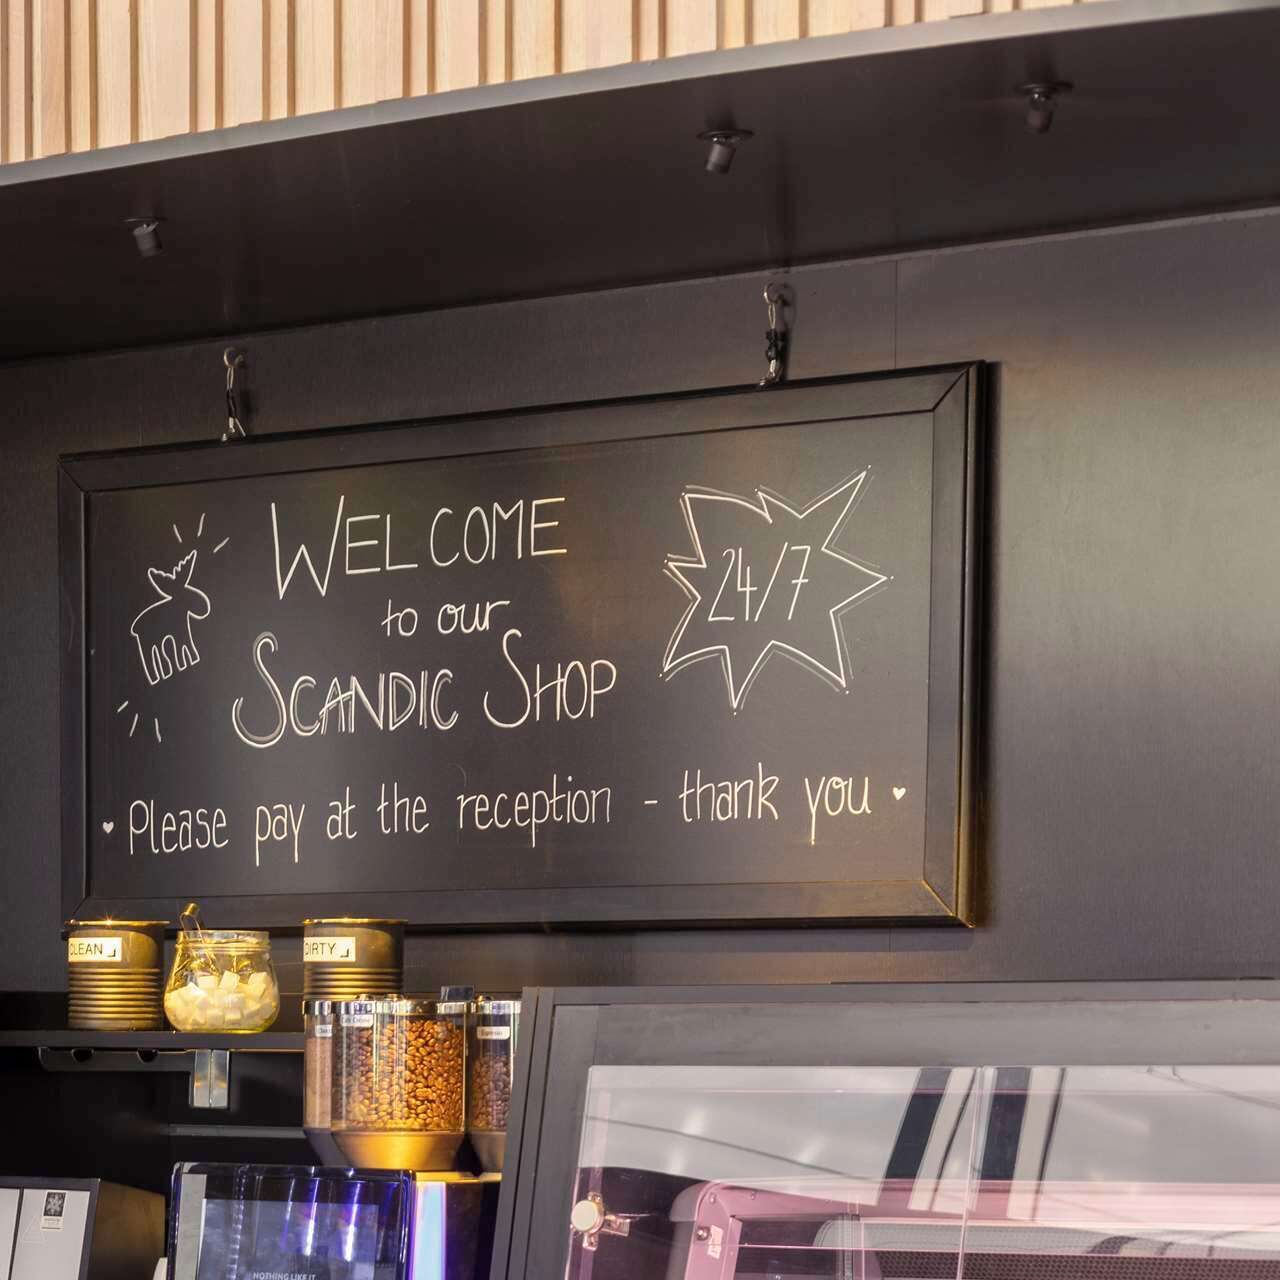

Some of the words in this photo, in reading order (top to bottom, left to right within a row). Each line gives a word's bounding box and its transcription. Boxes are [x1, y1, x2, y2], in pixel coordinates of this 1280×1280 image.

[270, 494, 568, 601] WELCOME
[706, 542, 811, 623] 24/7
[381, 599, 418, 637] to
[437, 598, 513, 635] our
[231, 631, 460, 749] SCANDIC
[483, 630, 618, 729] SHOP
[130, 799, 228, 855] Please
[255, 804, 305, 867] pay
[326, 786, 358, 840] at
[376, 781, 430, 835] the
[456, 773, 611, 848] reception
[679, 762, 780, 823] thank
[805, 773, 871, 845] you
[253, 1272, 289, 1280] NOTHING
